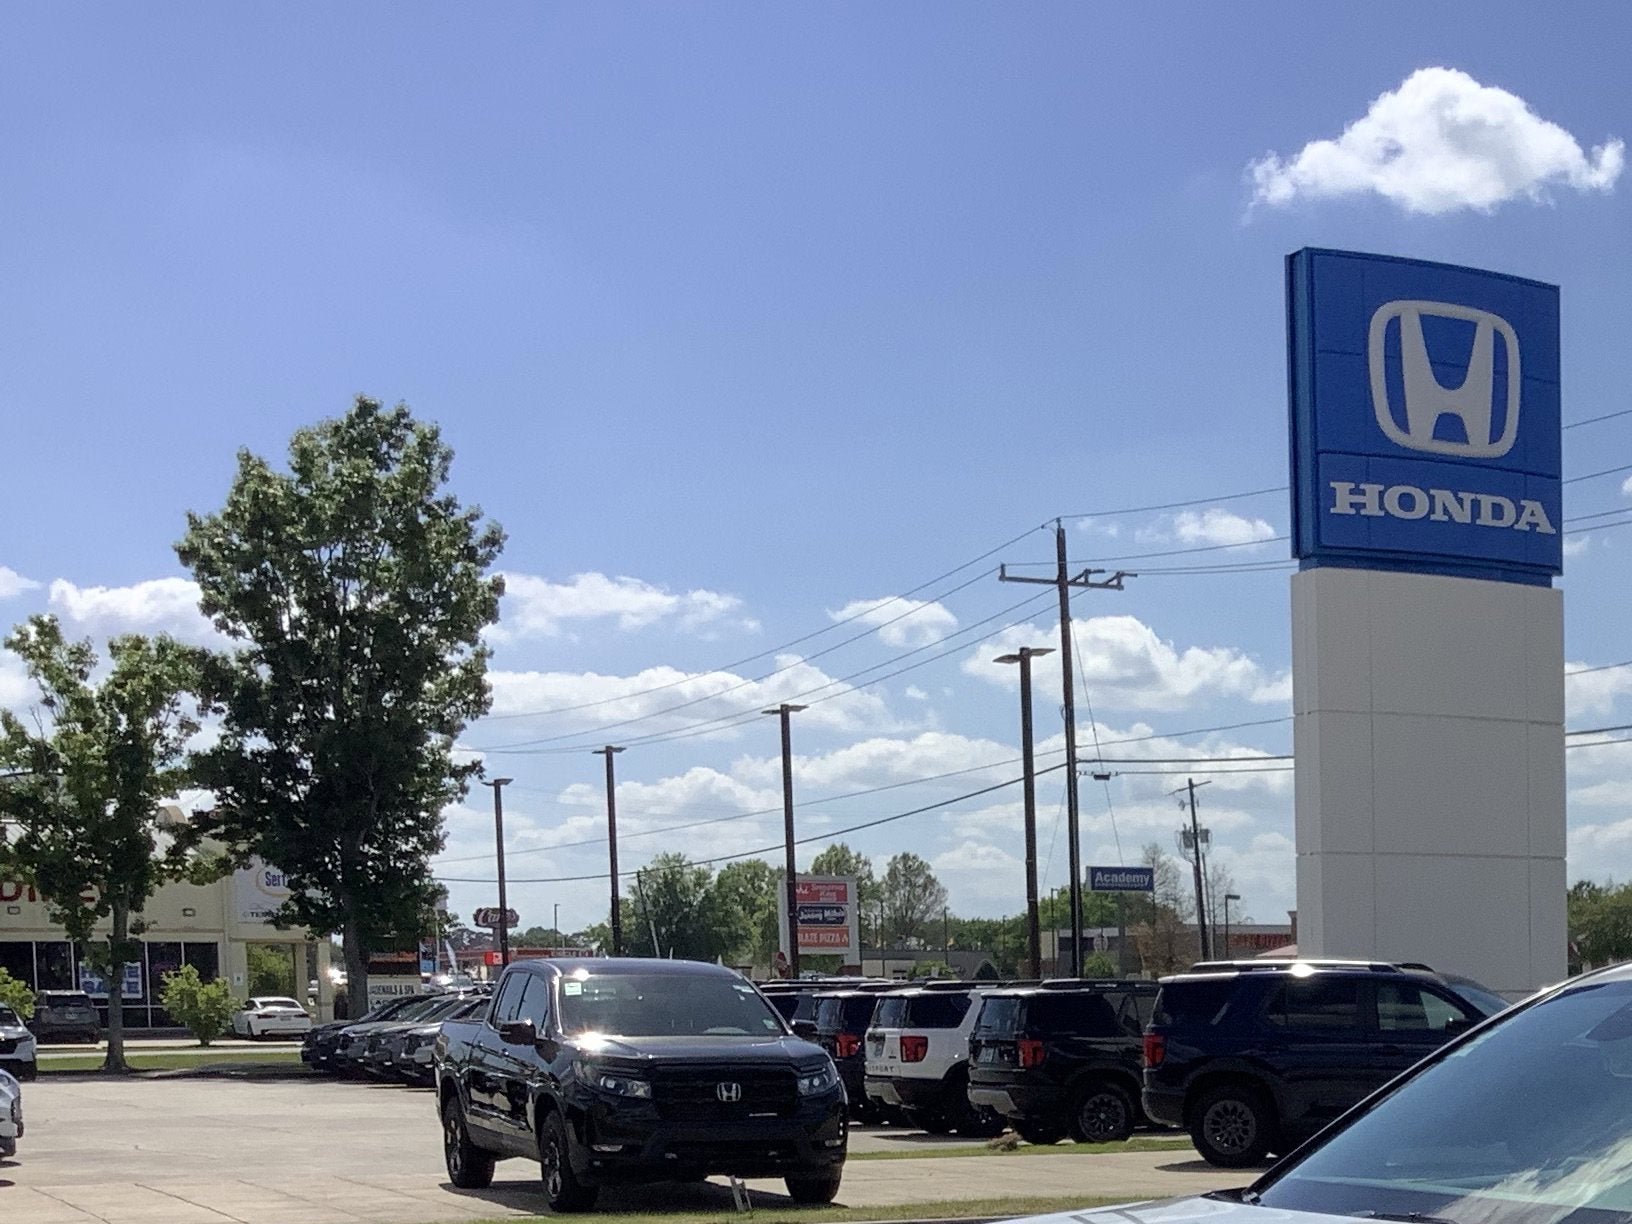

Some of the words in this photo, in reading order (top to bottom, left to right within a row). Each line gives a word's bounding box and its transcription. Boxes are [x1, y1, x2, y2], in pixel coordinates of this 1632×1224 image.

[1330, 481, 1556, 534] HONDA
[265, 871, 288, 886] Sert
[1095, 871, 1150, 886] Academy
